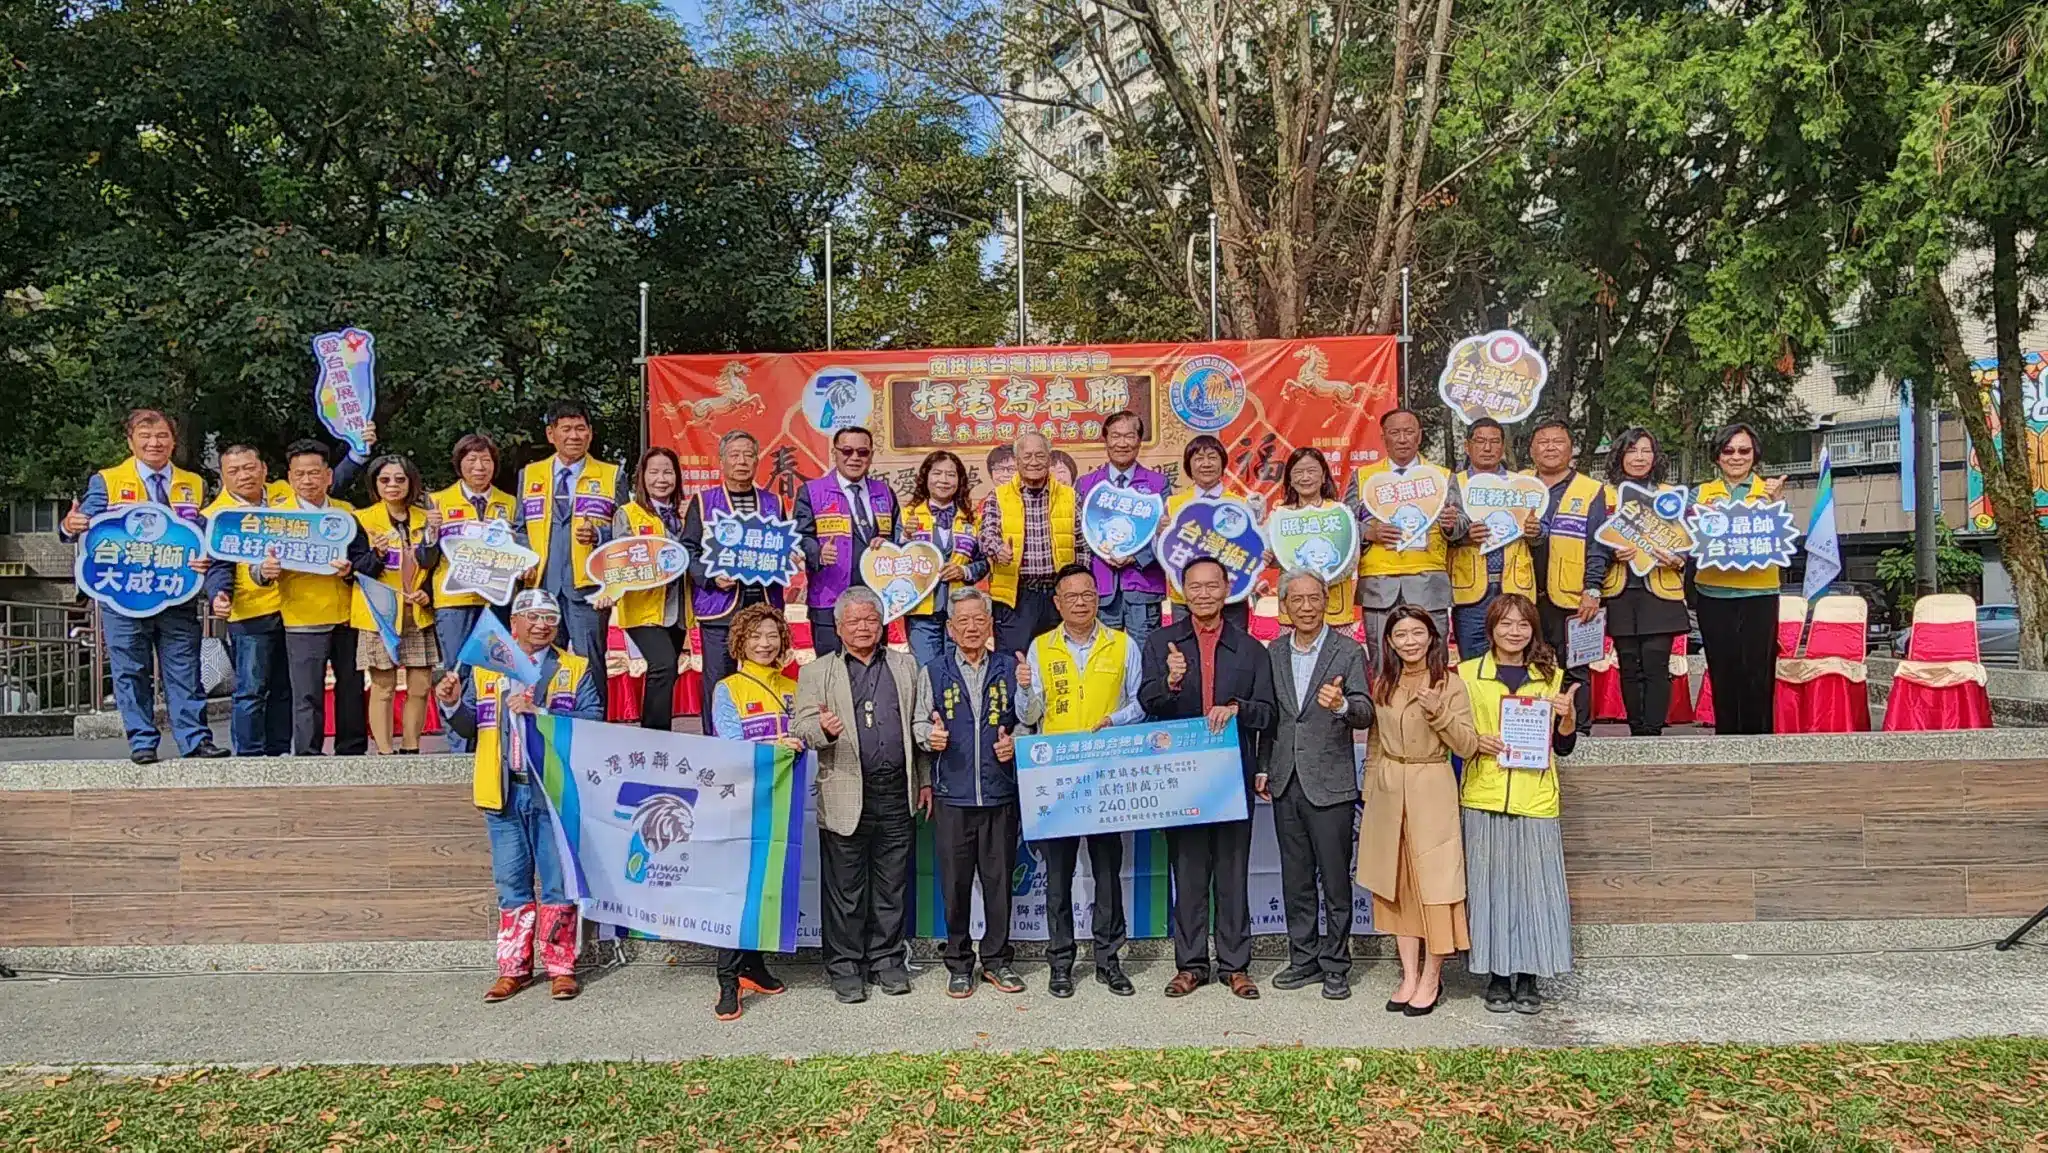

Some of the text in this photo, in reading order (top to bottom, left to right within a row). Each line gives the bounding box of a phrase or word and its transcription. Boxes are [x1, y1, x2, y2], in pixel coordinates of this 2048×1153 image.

[911, 376, 1129, 423] 揮毫寫春聯
[1375, 476, 1437, 505] 愛無限
[1468, 487, 1544, 509] 服務社會
[1096, 491, 1153, 519] 就是帥
[240, 513, 311, 539] 台灣獅
[1281, 514, 1344, 537] 照過來
[1731, 514, 1775, 534] 最帥
[744, 528, 784, 551] 最帥
[1706, 536, 1782, 557] 台灣獅!
[607, 543, 650, 564] 一定
[717, 547, 788, 573] 台灣獅!
[873, 555, 933, 577] 做愛心
[94, 566, 185, 598] 大成功
[626, 908, 658, 924] LIONS
[662, 914, 697, 930] UNION
